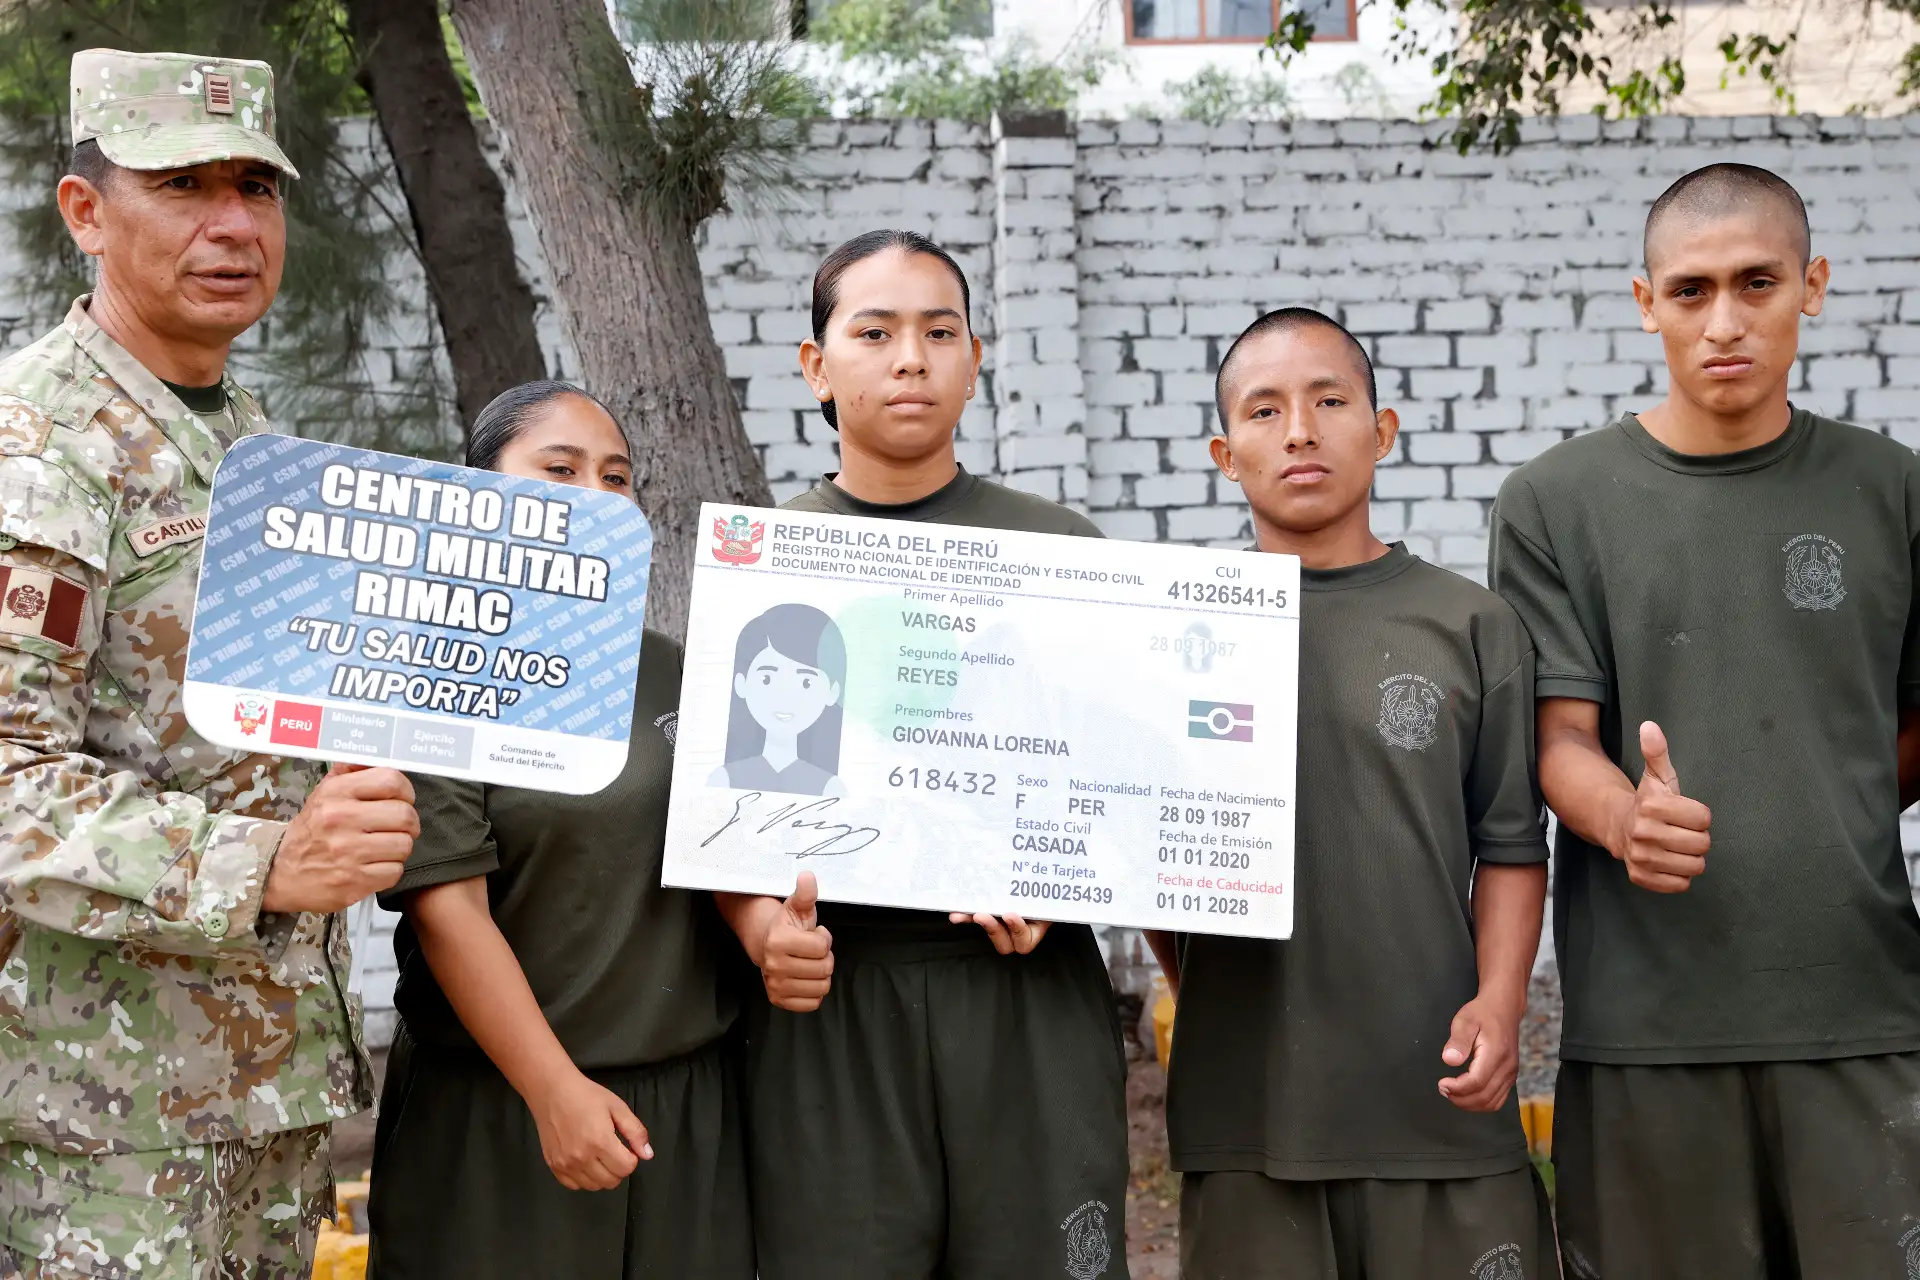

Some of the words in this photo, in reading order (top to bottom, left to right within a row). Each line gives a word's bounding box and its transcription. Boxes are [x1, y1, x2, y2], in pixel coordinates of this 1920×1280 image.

[242, 449, 271, 470] CSM
[209, 500, 225, 518] SM
[272, 463, 301, 484] CSM
[320, 463, 503, 532] CENTRO
[510, 494, 571, 545] DE
[206, 525, 234, 547] CSM
[773, 523, 891, 550] REPÚBLICA
[898, 535, 937, 553] DEL
[943, 539, 998, 559] PERÚ
[1781, 533, 1812, 553] EJERCITO
[1813, 533, 1827, 543] DEL
[1828, 539, 1846, 555] PERU
[219, 550, 248, 572] CSM
[263, 505, 418, 569] SALUD
[424, 530, 609, 602] MILITAR
[772, 542, 840, 559] REGISTRO
[844, 549, 912, 566] NACIONAL
[915, 556, 933, 568] DE
[936, 557, 1041, 577] IDENTIFICACIÓN
[1044, 567, 1052, 578] Y
[1055, 568, 1108, 582] ESTADO
[1112, 573, 1145, 586] CIVIL
[771, 556, 856, 574] DOCUMENTO
[859, 564, 927, 581] NACIONAL
[930, 571, 948, 583] DE
[951, 573, 1022, 589] IDENTIDAD
[1215, 566, 1242, 579] CUI
[234, 576, 263, 598] CSM
[903, 588, 947, 603] Primer
[950, 592, 1005, 608] Apellido
[1167, 580, 1288, 609] 41326541-5
[250, 597, 279, 619] CSM
[353, 570, 512, 635] RIMAC
[546, 610, 572, 631] CSM
[901, 611, 977, 633] VARGAS
[560, 630, 587, 651] CSM
[1150, 635, 1168, 652] 28
[187, 656, 213, 679] CSM
[272, 646, 300, 667] CSM
[361, 628, 487, 674] SALUD
[491, 648, 571, 688] NOS
[575, 649, 601, 670] CSM
[899, 645, 957, 661] Segundo
[960, 651, 1015, 667] Apellido
[288, 664, 316, 687] CSM
[589, 668, 616, 690] CSM
[897, 666, 958, 686] REYES
[1378, 673, 1413, 690] EJERCITO
[1414, 674, 1428, 685] DEL
[1429, 682, 1446, 700] PERU
[604, 687, 629, 709] CSM
[331, 712, 387, 728] Ministerio
[522, 705, 549, 727] CSM
[894, 703, 974, 721] Prenombres
[280, 718, 313, 732] PERÚ
[351, 728, 364, 739] de
[333, 738, 378, 755] Defensa
[410, 743, 429, 754] del
[430, 744, 455, 759] Perú
[501, 744, 543, 758] Comando
[544, 750, 556, 760] de
[892, 725, 989, 750] GIOVANNA
[994, 734, 1071, 757] LORENA
[489, 752, 514, 765] Salud
[516, 756, 530, 767] del
[531, 759, 566, 771] Ejército
[888, 766, 997, 796] 618432
[1016, 774, 1049, 788] Sexo
[1069, 778, 1152, 797] Nacionalidad
[1015, 792, 1026, 809] F
[1068, 797, 1106, 817] PER
[1160, 786, 1195, 801] Fecha
[1198, 789, 1214, 802] de
[1217, 791, 1286, 808] Nacimiento
[1015, 817, 1060, 832] Estado
[1063, 821, 1092, 835] Civil
[1159, 805, 1180, 823] 28
[1185, 807, 1206, 825] 09
[1211, 809, 1251, 829] 1987
[1012, 833, 1088, 856] CASADA
[1159, 829, 1197, 844] Fecha
[1200, 832, 1217, 845] de
[1221, 834, 1273, 850] Emisión
[1158, 846, 1177, 863] 01
[1184, 848, 1202, 866] 01
[1209, 850, 1250, 870] 2020
[1031, 862, 1048, 875] de
[1052, 864, 1097, 880] Tarjeta
[1010, 879, 1113, 904] 2000025439
[1157, 872, 1193, 887] Fecha
[1196, 876, 1213, 889] de
[1216, 878, 1284, 895] Caducidad
[1157, 892, 1175, 910] 01
[1182, 894, 1201, 912] 01
[1208, 896, 1249, 916] 2028
[1060, 1203, 1088, 1231] EJERCITO
[1469, 1248, 1498, 1275] EJERCITO
[1498, 1243, 1510, 1252] DEL
